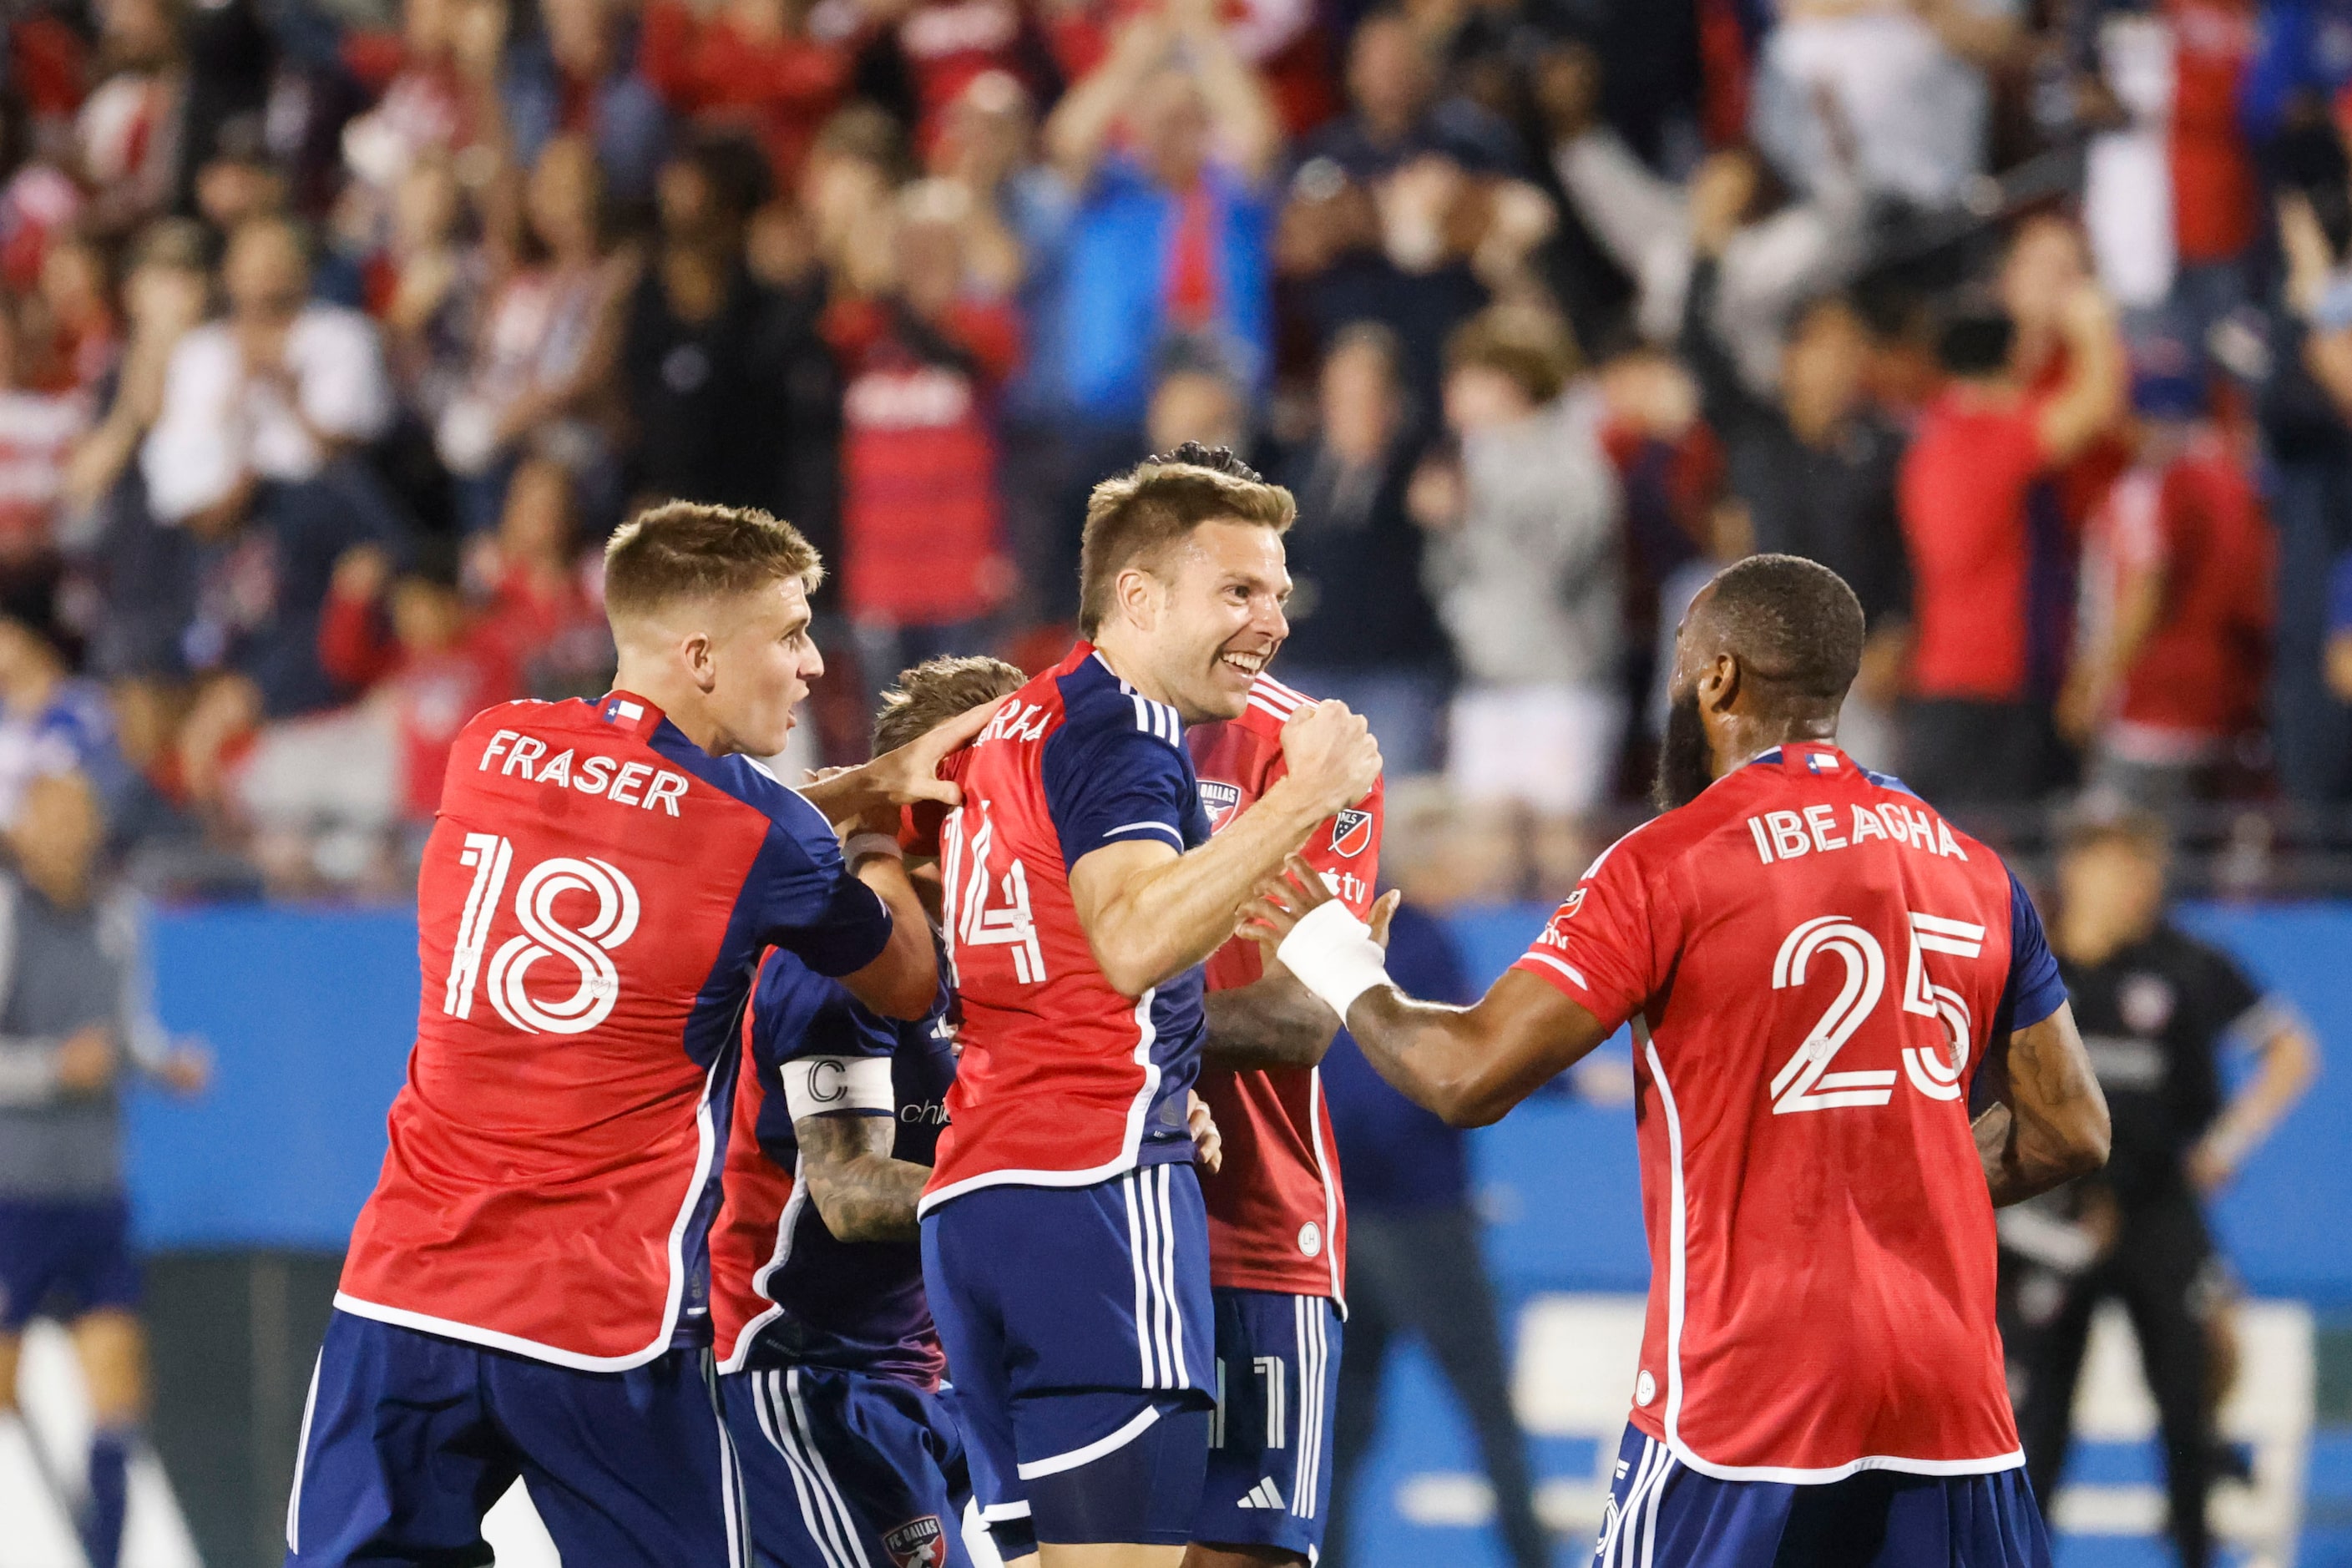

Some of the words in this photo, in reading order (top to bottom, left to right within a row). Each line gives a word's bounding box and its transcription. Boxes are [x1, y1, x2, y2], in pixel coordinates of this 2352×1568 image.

[478, 729, 689, 818] FRASER
[1748, 802, 1969, 864] IBEAGHA
[940, 799, 1046, 989] 14
[1342, 872, 1366, 905] tv
[443, 832, 641, 1035] 18
[1771, 911, 1986, 1115] 25
[807, 1059, 848, 1103] C
[903, 1520, 938, 1542] DALLAS
